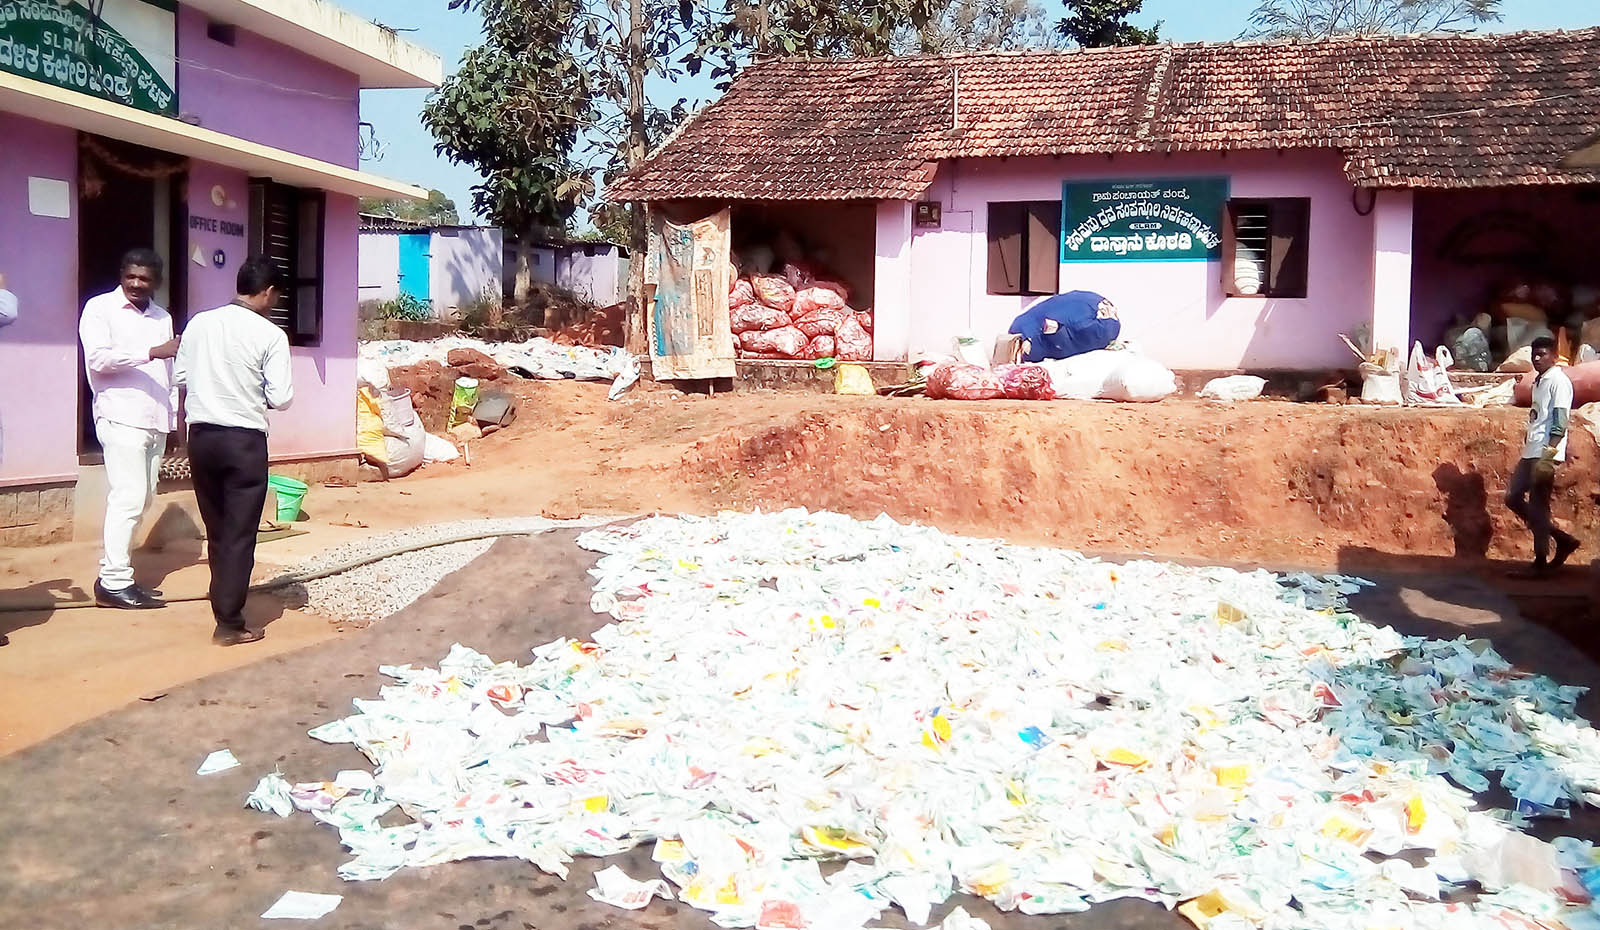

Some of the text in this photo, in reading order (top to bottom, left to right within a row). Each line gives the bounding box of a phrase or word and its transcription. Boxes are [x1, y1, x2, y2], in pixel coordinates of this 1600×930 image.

[43, 31, 85, 57] SLRM
[138, 70, 172, 109] ಘಟಕ
[1092, 191, 1112, 203] ಗ್ರಾಮ
[1112, 189, 1161, 201] ಪಂಚಾಯತ್
[189, 215, 244, 237] OFFICE ROOM
[1097, 205, 1117, 228] ದ್ರವ
[1160, 204, 1202, 234] ನಿರ್ವಹಣಾ
[1089, 232, 1144, 256] ದಾಸ್ತಾನು
